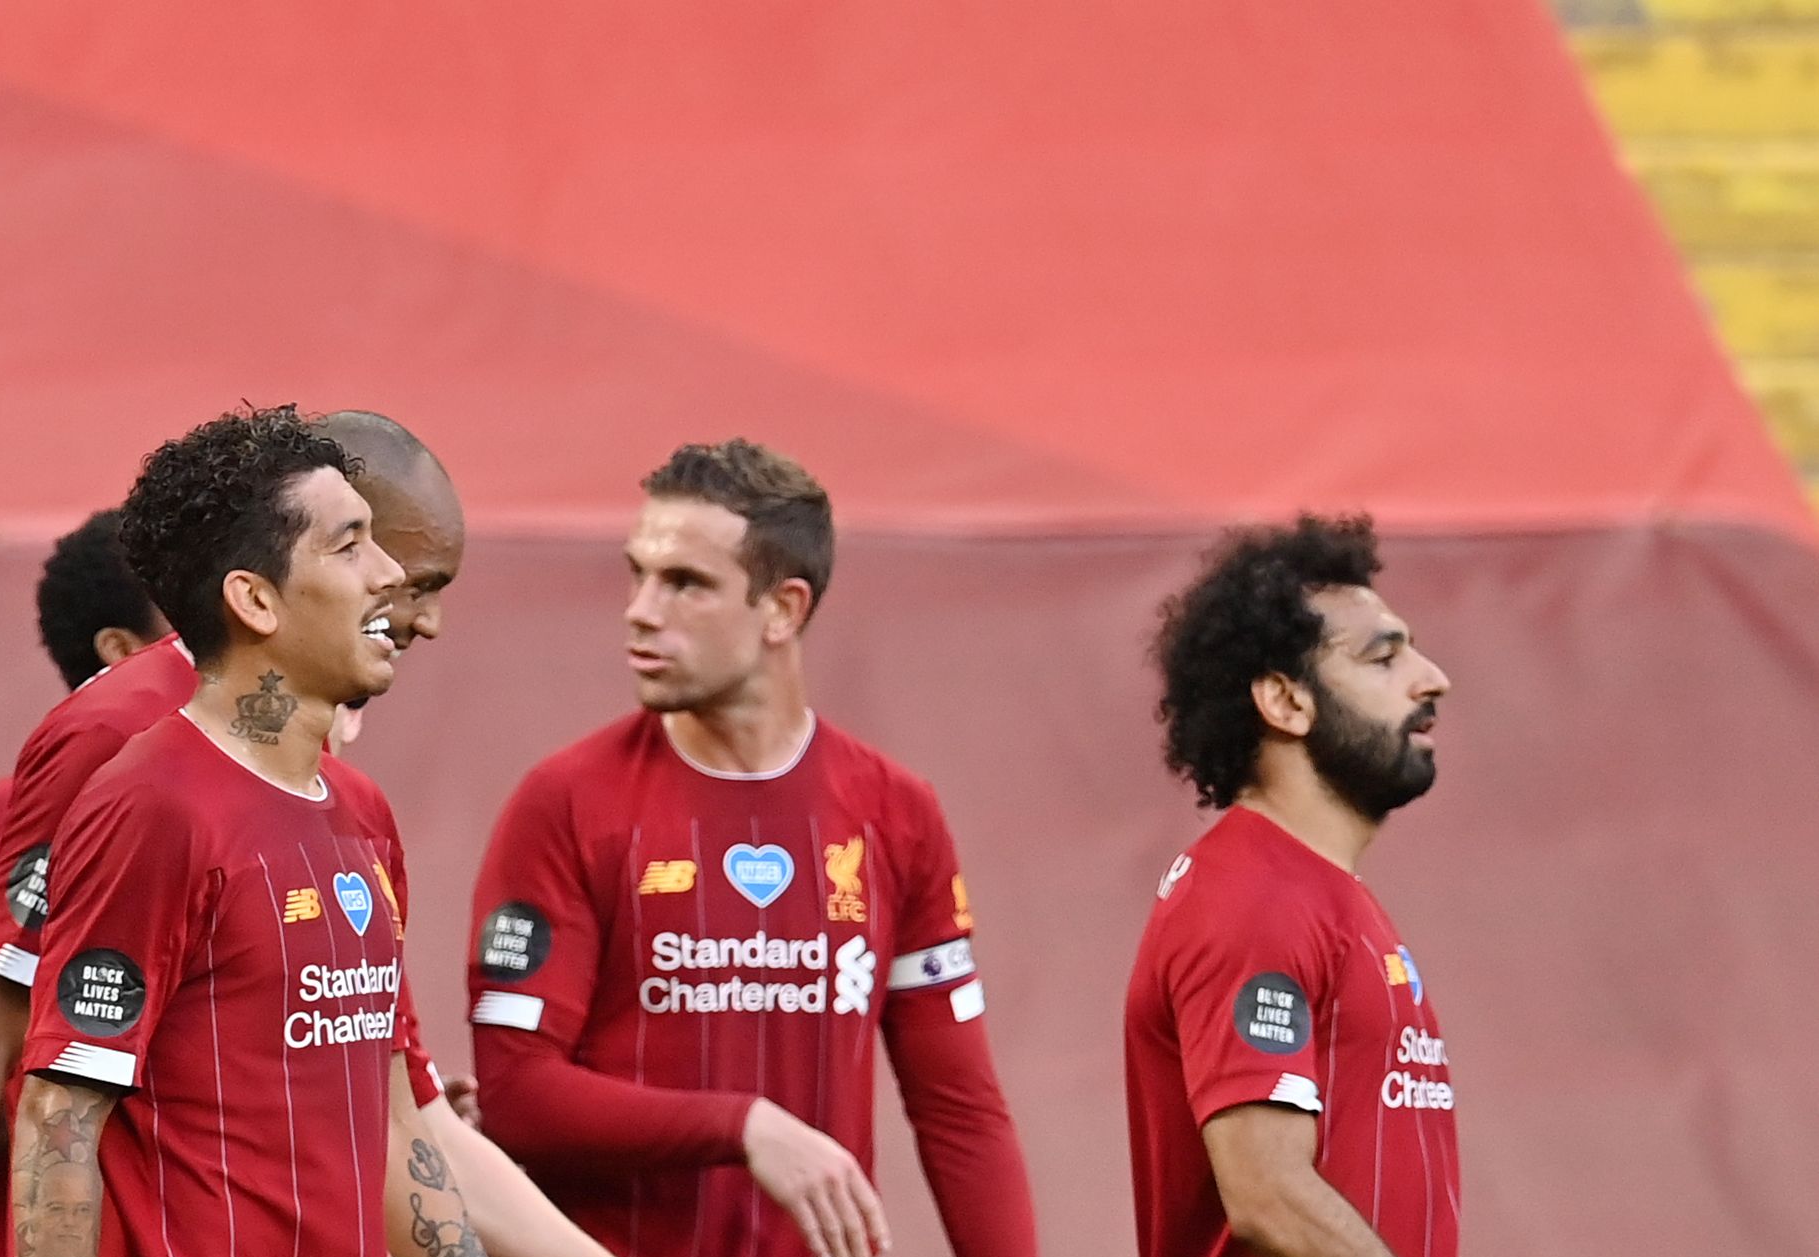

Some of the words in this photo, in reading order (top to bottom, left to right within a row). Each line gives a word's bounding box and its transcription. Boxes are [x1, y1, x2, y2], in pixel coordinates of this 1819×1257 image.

[650, 931, 828, 970] Standard
[299, 956, 399, 1002] Standard
[82, 983, 120, 1002] LIVES
[639, 976, 827, 1014] Chartered
[74, 999, 124, 1021] MATTER
[1256, 1005, 1291, 1026] LIVES
[1249, 1020, 1295, 1044] MATTER
